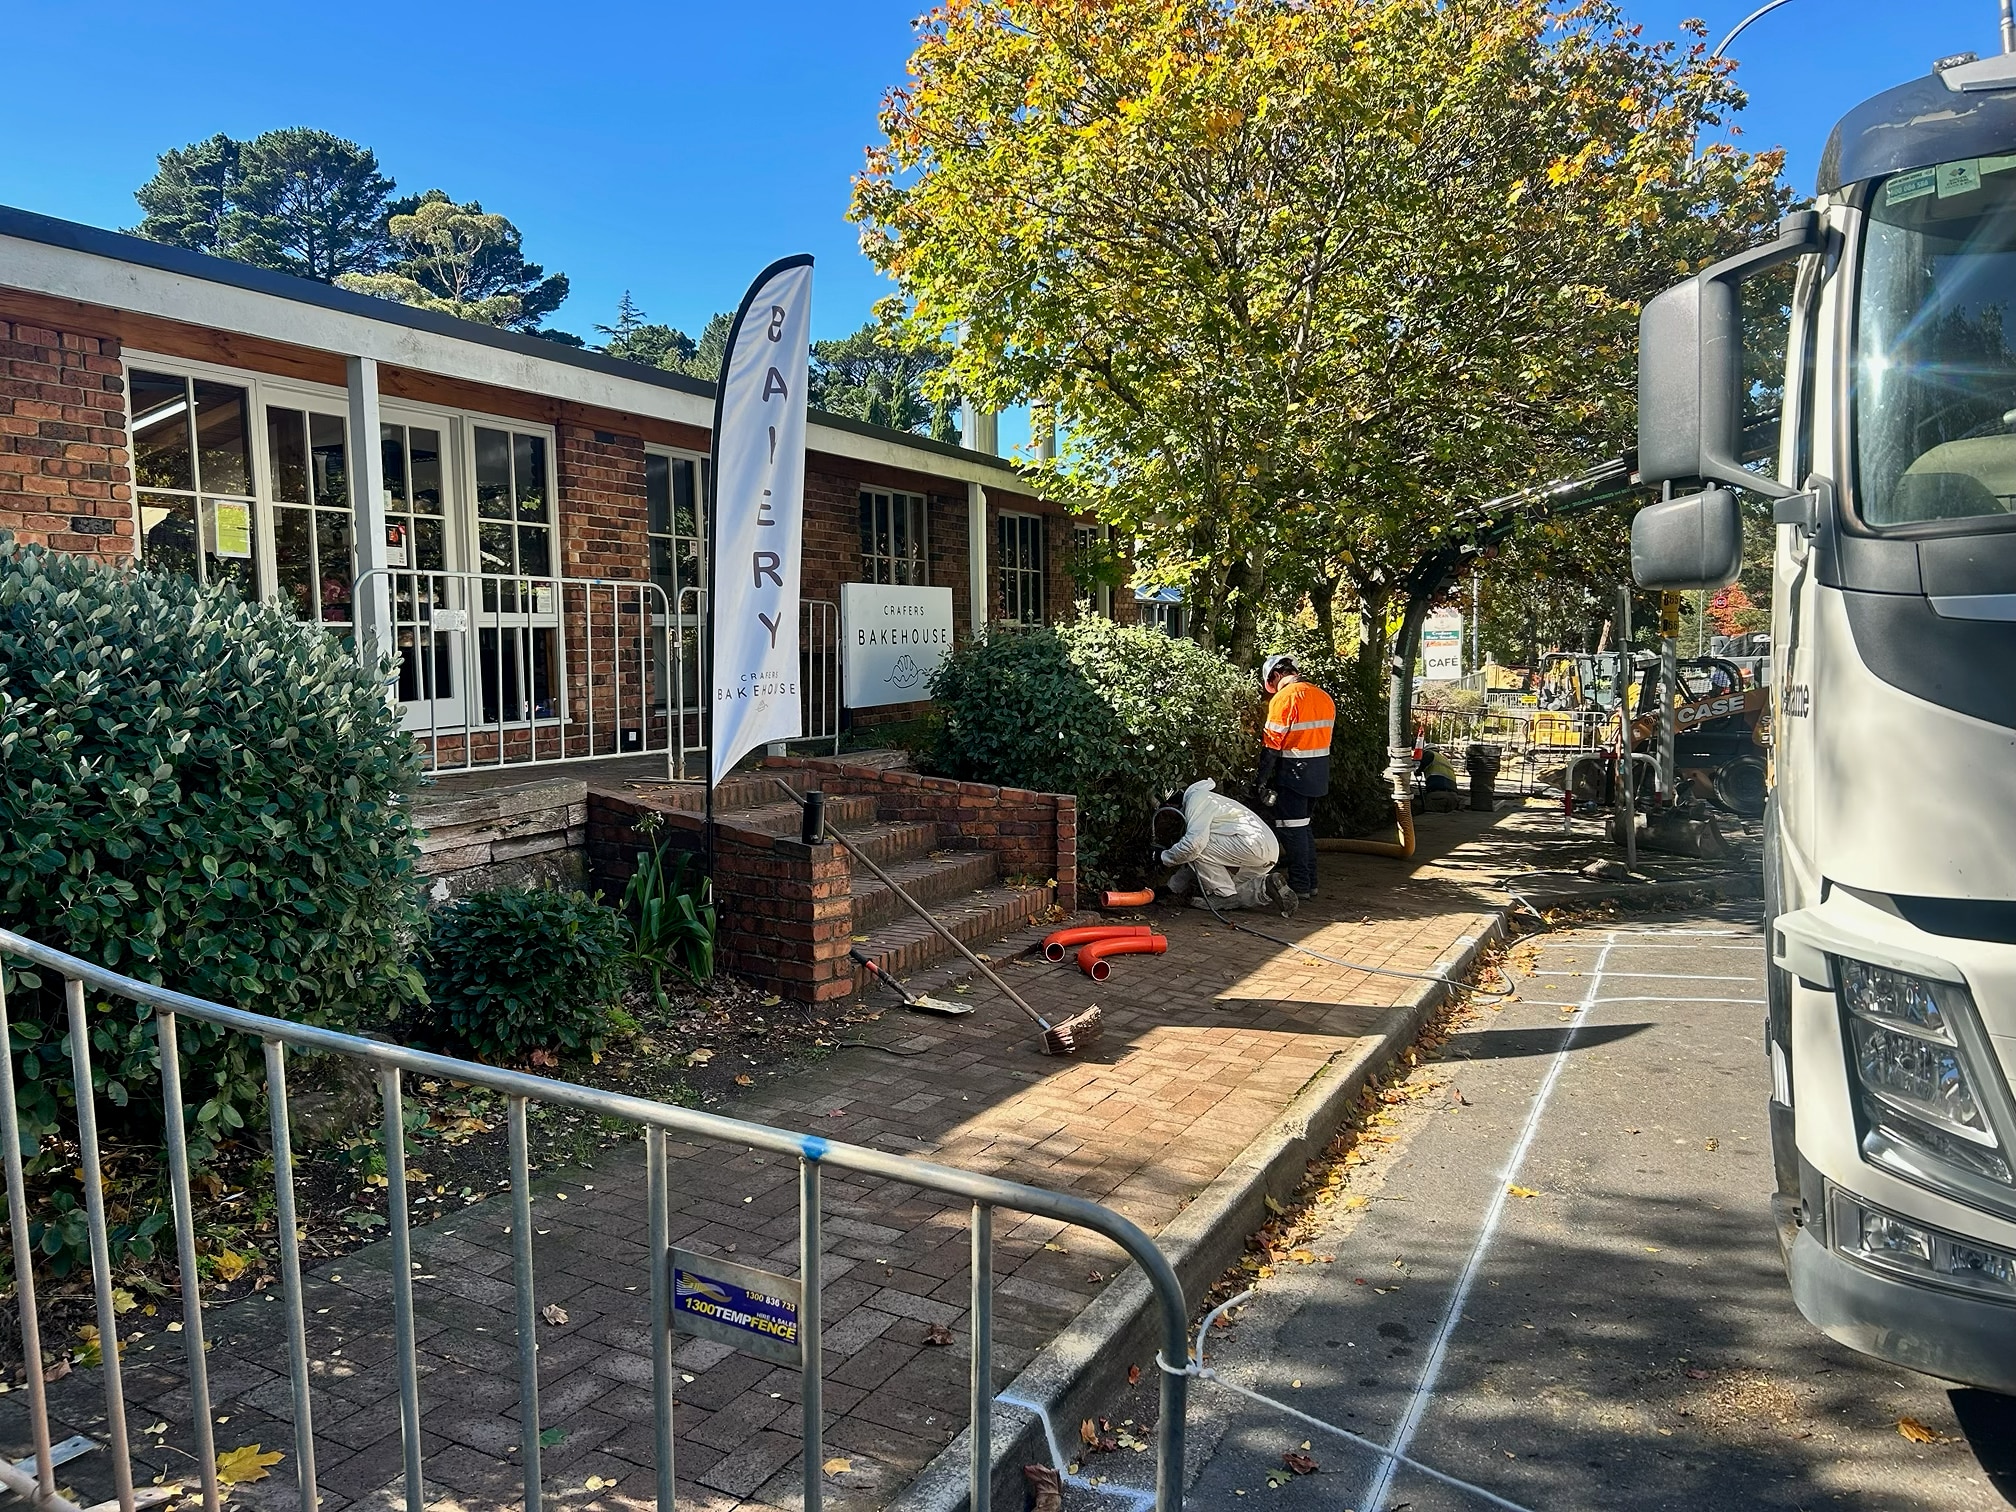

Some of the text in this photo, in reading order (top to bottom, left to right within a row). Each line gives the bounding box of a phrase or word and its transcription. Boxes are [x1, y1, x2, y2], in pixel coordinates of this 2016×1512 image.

[884, 605, 924, 616] CRAFERS
[858, 629, 946, 646] BAKEHOUSE
[1428, 655, 1459, 668] CAFÉ
[740, 671, 779, 682] CRAFERS
[1677, 695, 1745, 723] CASE
[745, 1290, 764, 1303] 1300
[781, 1301, 796, 1312] 733
